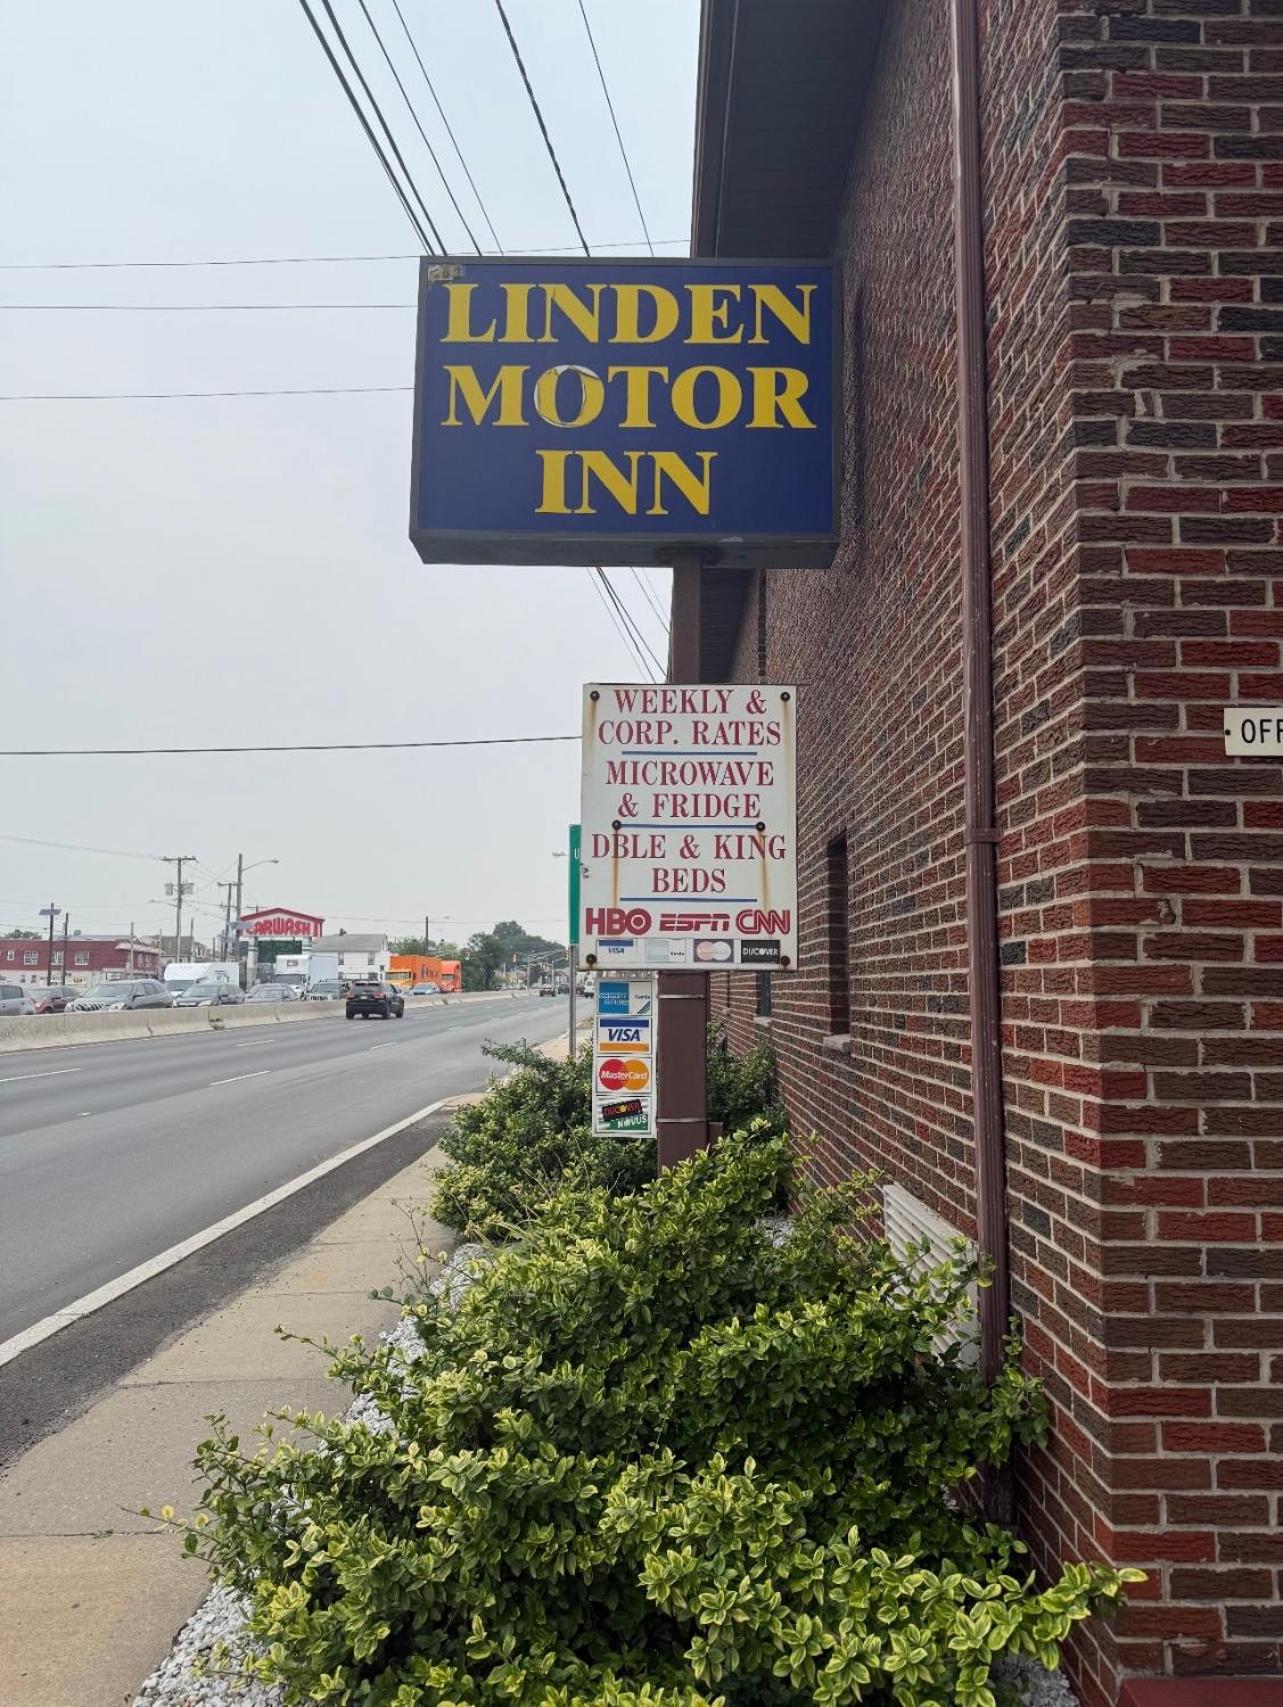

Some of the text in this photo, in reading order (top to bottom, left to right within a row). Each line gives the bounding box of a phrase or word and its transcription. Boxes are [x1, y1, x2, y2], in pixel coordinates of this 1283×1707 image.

[440, 283, 818, 346] LINDEN
[441, 364, 818, 430] MOTOR
[535, 450, 719, 517] INN
[614, 689, 767, 715] WEEKLY &
[598, 720, 781, 745] CORP. RATES
[605, 760, 775, 786] MICROWAVE
[617, 793, 762, 818] & FRIDGE
[591, 833, 787, 861] DBLE & KING
[651, 868, 727, 894] BEDS
[585, 907, 791, 936] HBO ESPN CNN
[607, 1028, 641, 1042] VISA
[600, 1070, 647, 1081] MasterCard
